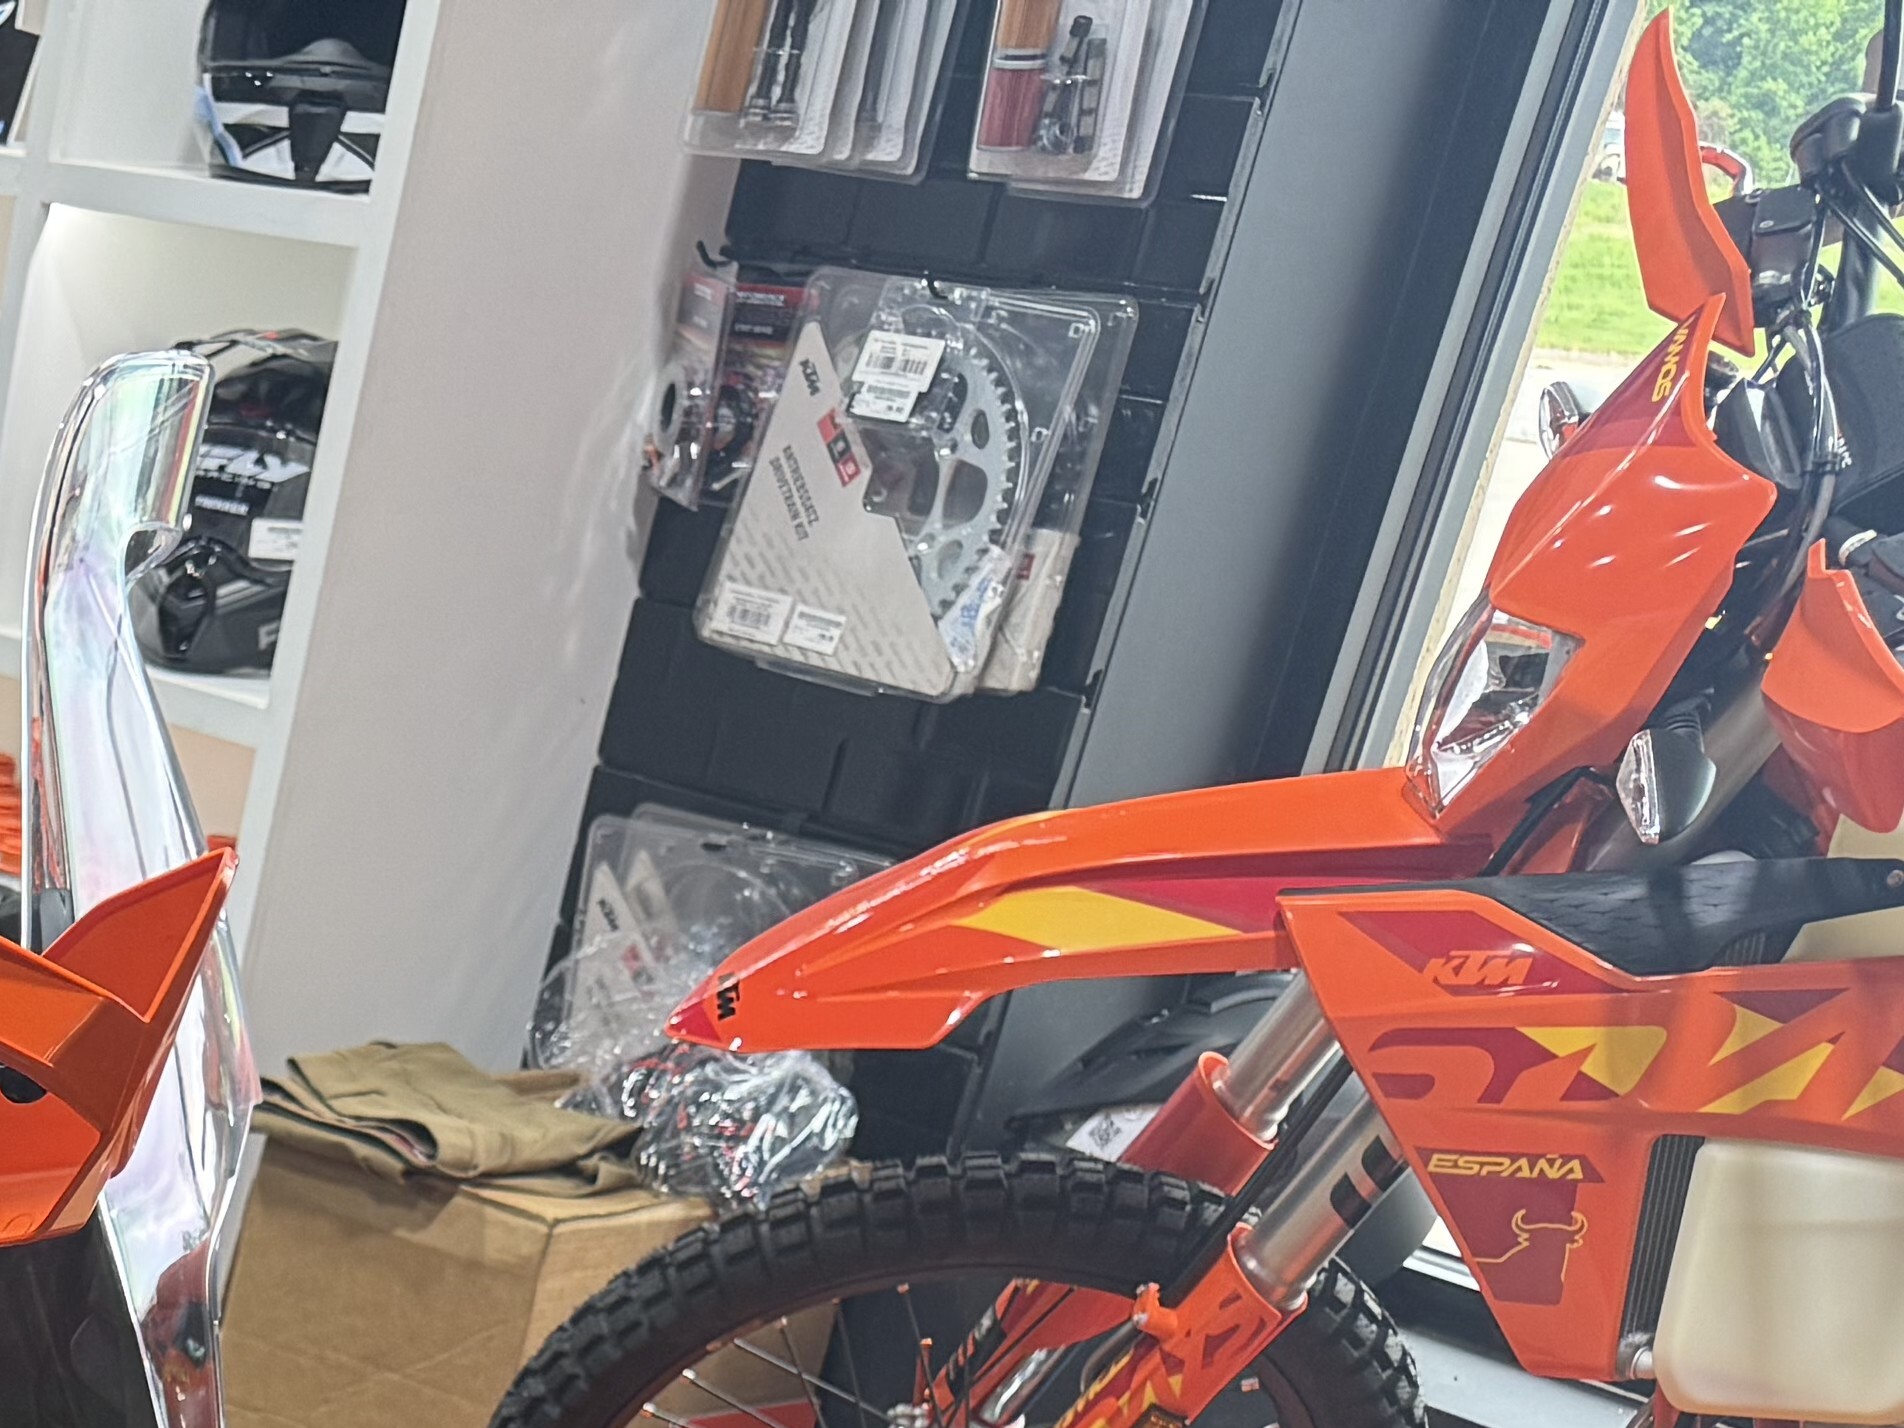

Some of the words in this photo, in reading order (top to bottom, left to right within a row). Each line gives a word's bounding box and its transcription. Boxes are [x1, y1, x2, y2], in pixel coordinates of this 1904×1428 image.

[799, 358, 821, 396] KTM
[1421, 950, 1534, 986] KTM
[1426, 1154, 1585, 1180] ESPAÑA
